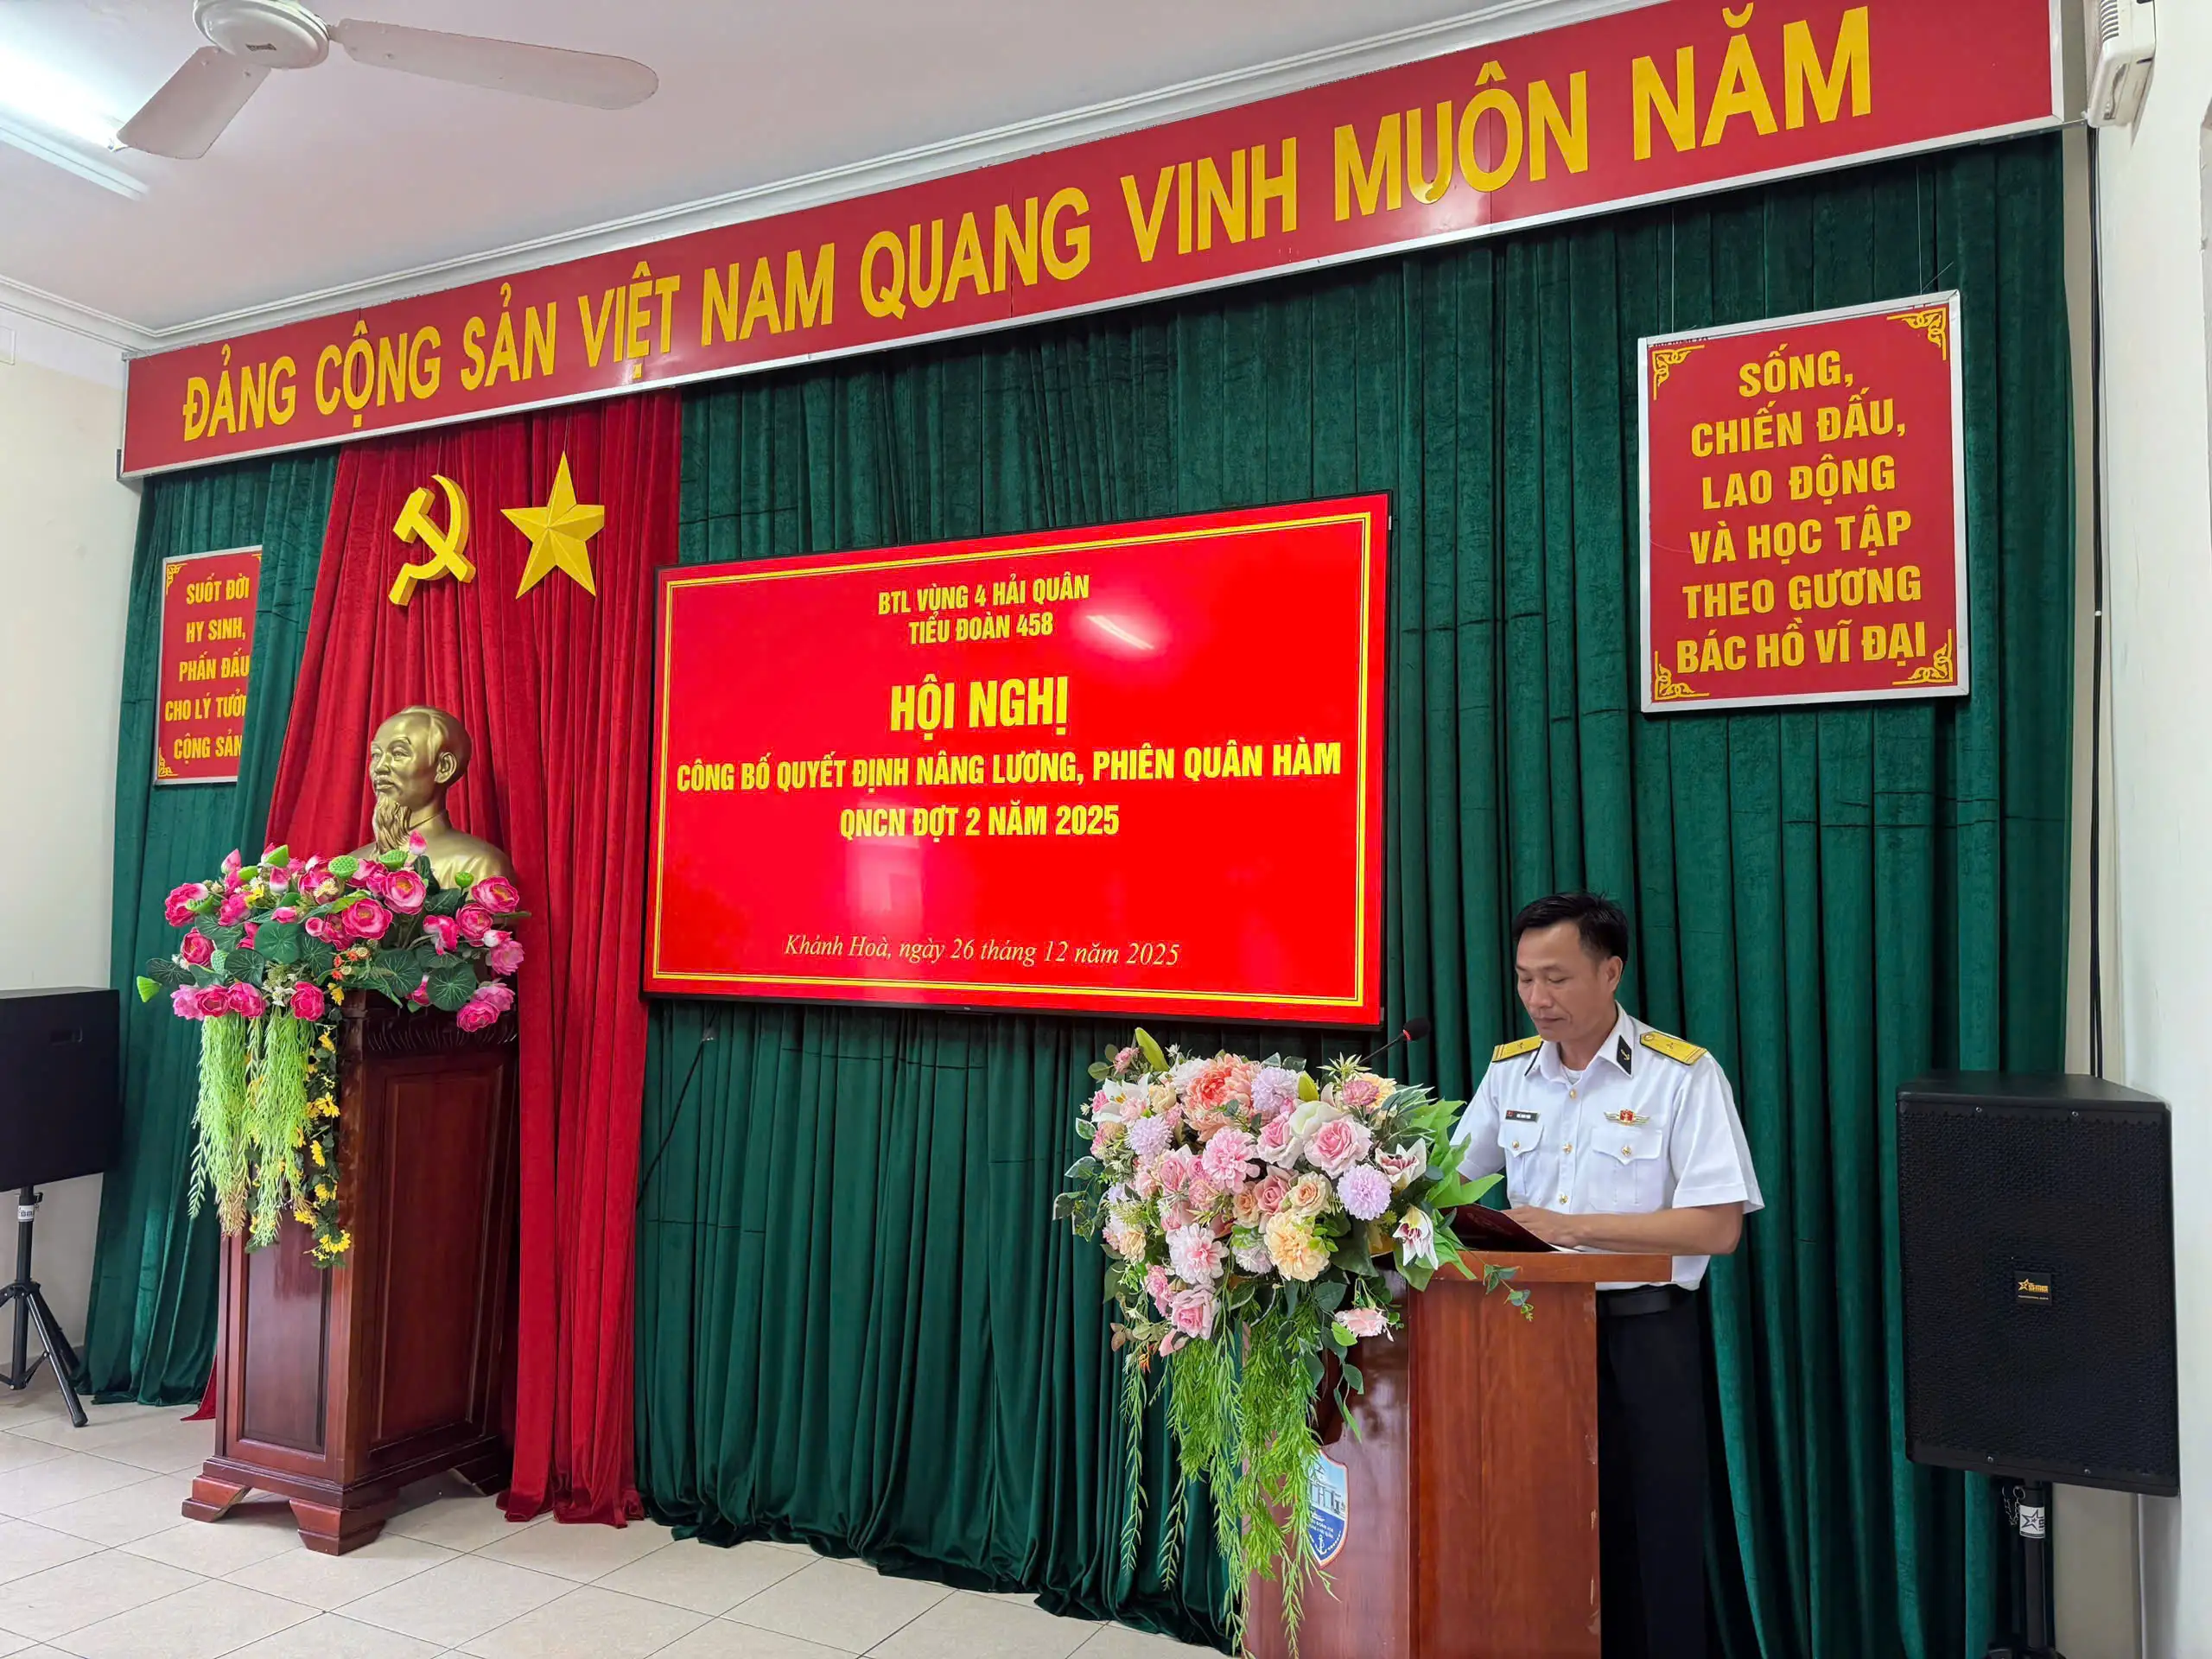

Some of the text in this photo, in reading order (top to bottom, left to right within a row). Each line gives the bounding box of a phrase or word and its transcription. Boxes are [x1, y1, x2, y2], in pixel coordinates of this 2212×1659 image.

[182, 2, 1872, 442] ĐẢNG CỘNG SẢN VIỆT NAM QUANG VINH MUÔN NĂM
[1738, 343, 1854, 398] SỐNG,
[1690, 387, 1906, 459] CHIẾN ĐẤU,
[1702, 454, 1896, 511] LAO ĐỘNG
[1689, 504, 1911, 566] VÀ HỌC TẬP
[186, 572, 250, 605] SUỐT ĐỜI
[878, 571, 1090, 615] BTL VÙNG 4 HẢI QUÂN
[1682, 565, 1922, 619] THEO GƯƠNG
[186, 616, 246, 643] HY SINH,
[909, 611, 1053, 645] TIỂU ĐOÀN 458
[1676, 616, 1926, 675] BÁC HỒ VĨ ĐẠI
[178, 647, 250, 682] PHẤN ĐẤU
[165, 699, 191, 722] CHO
[194, 692, 211, 720] LÝ
[891, 673, 1069, 741] HỘI NGHỊ
[174, 728, 242, 765] CỘNG SẢN
[677, 736, 1341, 793] CÔNG BỐ QUYẾT ĐỊNH NÂNG LƯƠNG, PHIÊN QUÂN HÀM
[839, 799, 1120, 842] QNCN ĐỢT 2 NĂM 2025
[785, 934, 1180, 967] Khánh Hoà, ngày 26 tháng 12 năm 2025
